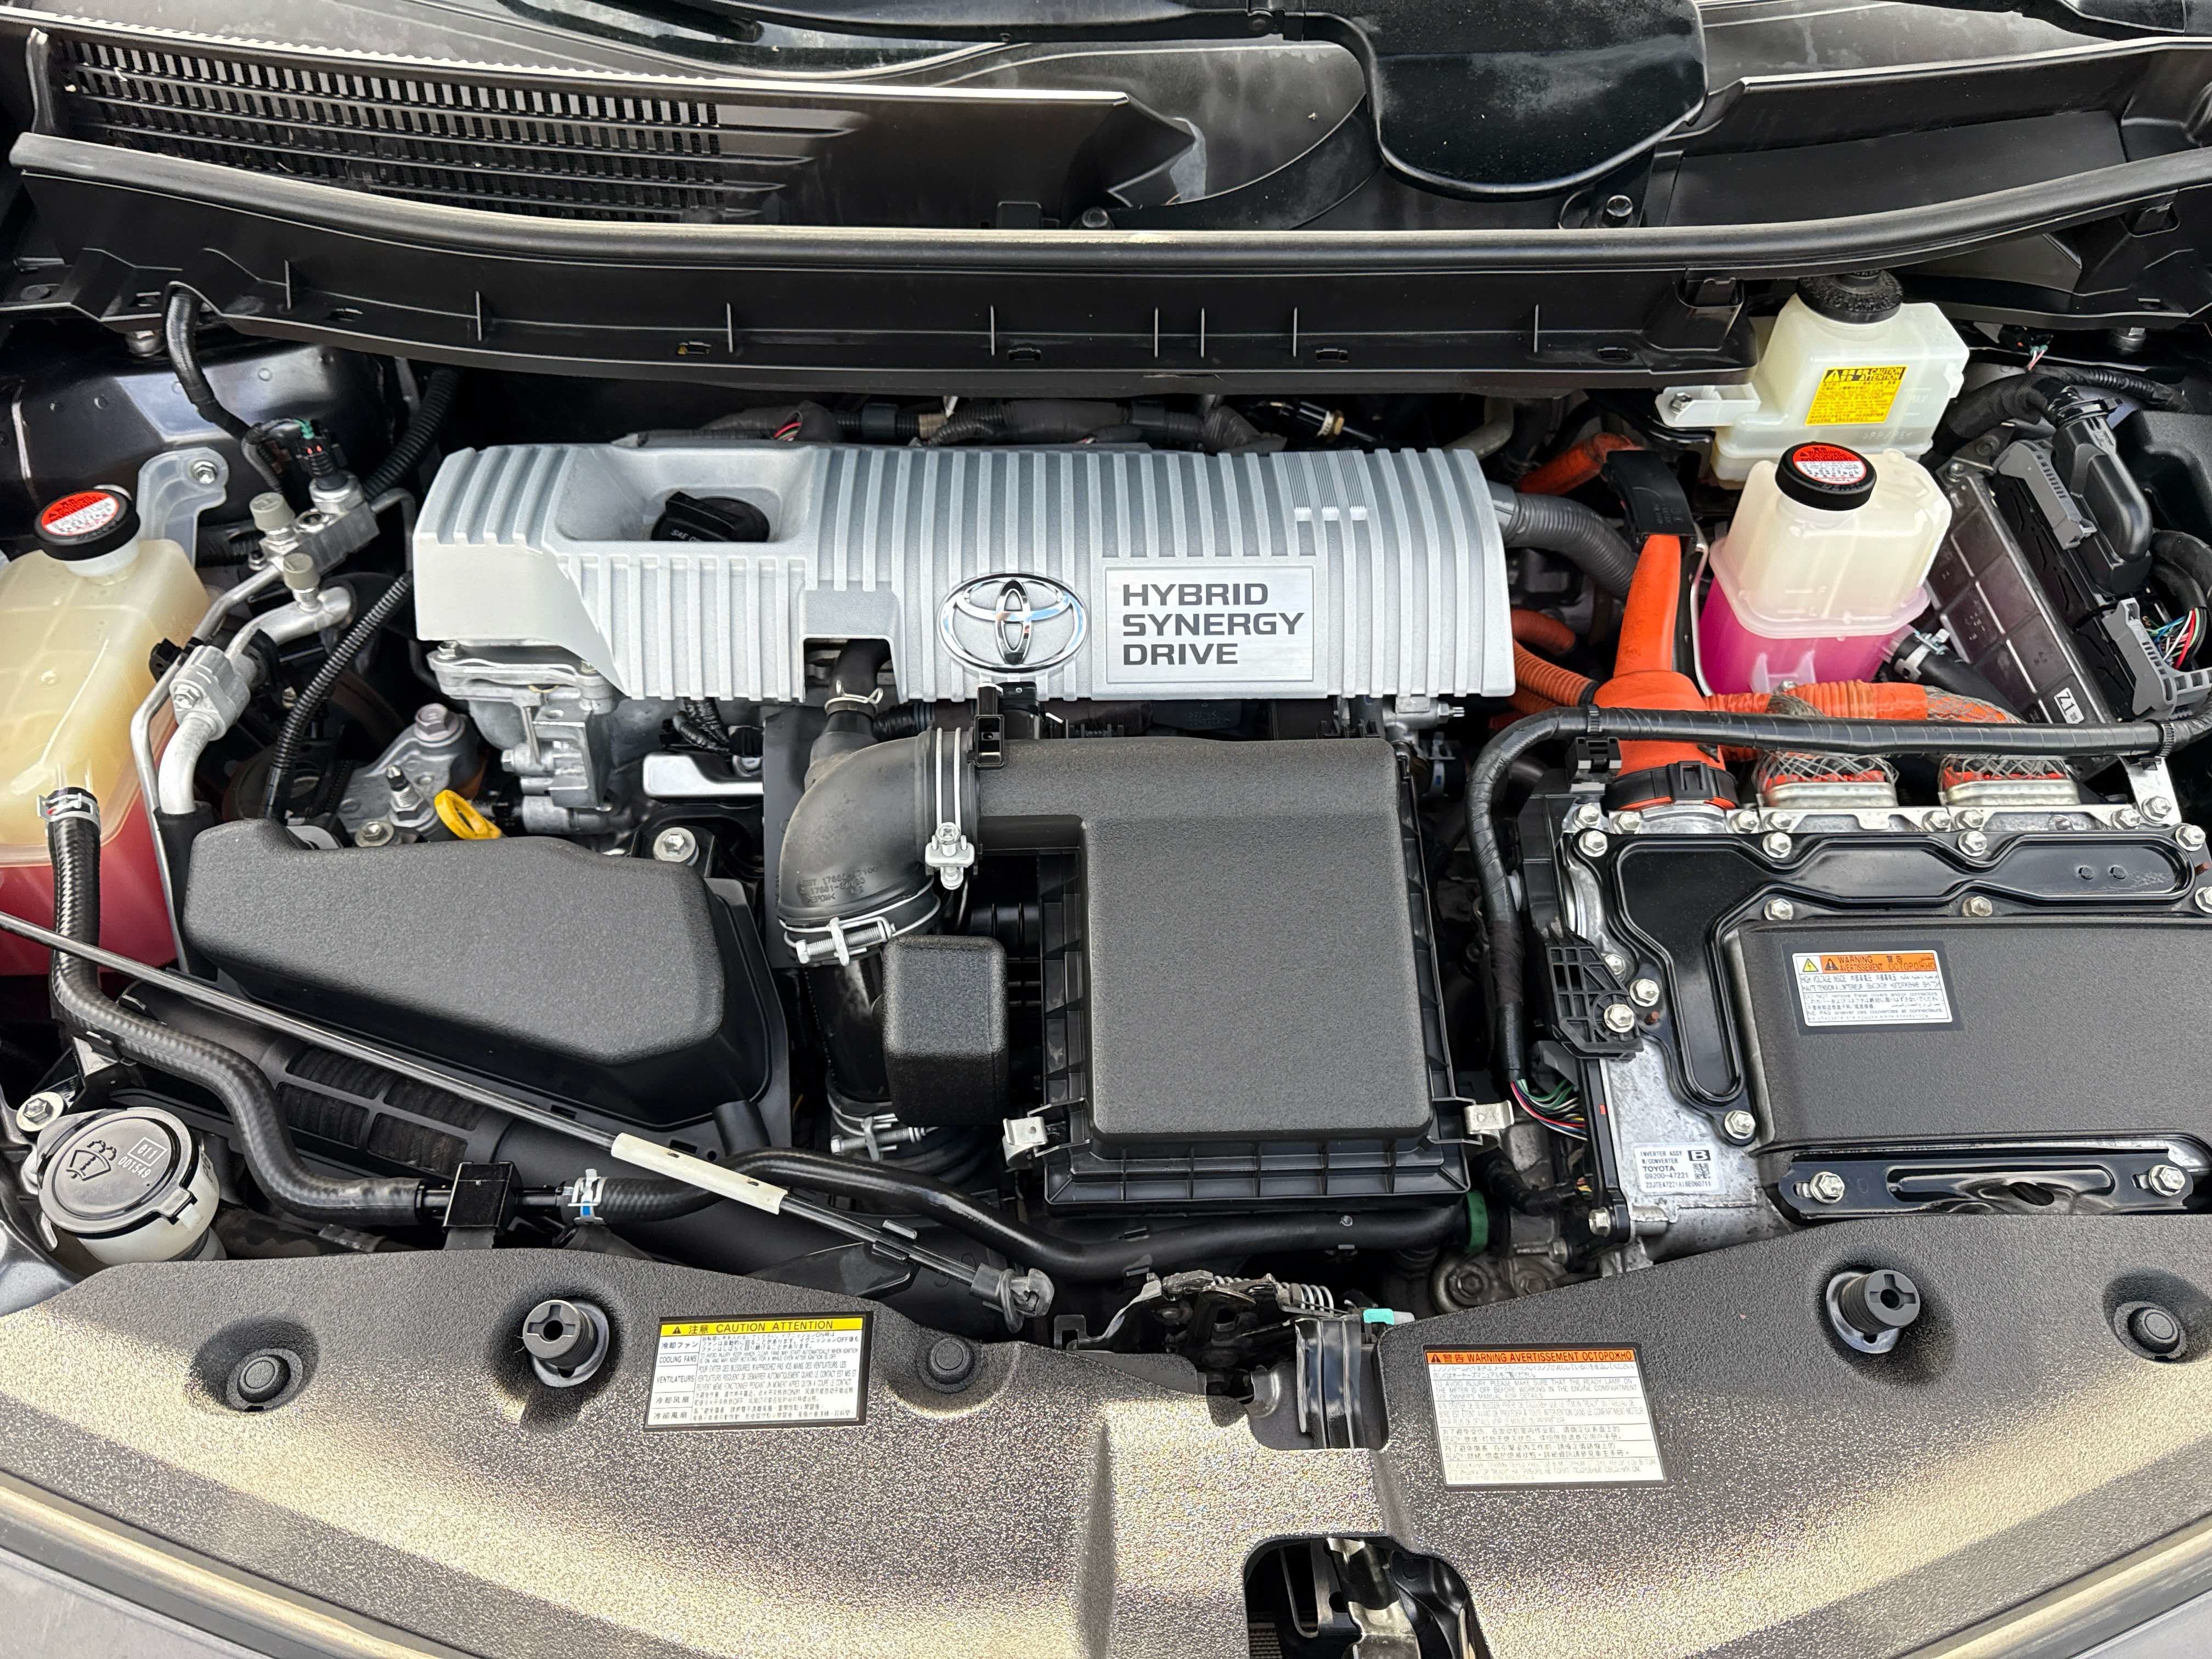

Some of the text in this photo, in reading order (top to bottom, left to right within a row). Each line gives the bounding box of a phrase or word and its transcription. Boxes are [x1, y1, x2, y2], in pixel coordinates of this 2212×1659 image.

[1123, 583, 1268, 606] HYBRID
[1123, 612, 1305, 636] SYNERGY
[1123, 643, 1238, 665] DRIVE
[2057, 690, 2075, 714] Z1
[1837, 955, 1873, 963] WARNING
[1839, 963, 1884, 972] AVERTISSEMENT
[137, 1144, 158, 1160] e11
[1690, 1150, 1709, 1160] B
[117, 1156, 152, 1178] 001549
[688, 1320, 833, 1334] 注意 CAUTION ATTENTION
[661, 1340, 698, 1349] 冷却ファン
[1442, 1351, 1633, 1363] 警告 WARNING AVERTISSEMENT ОСТОРОЖНО
[656, 1375, 695, 1384] VENTILATEURS
[655, 1396, 690, 1404] 冷却风扇
